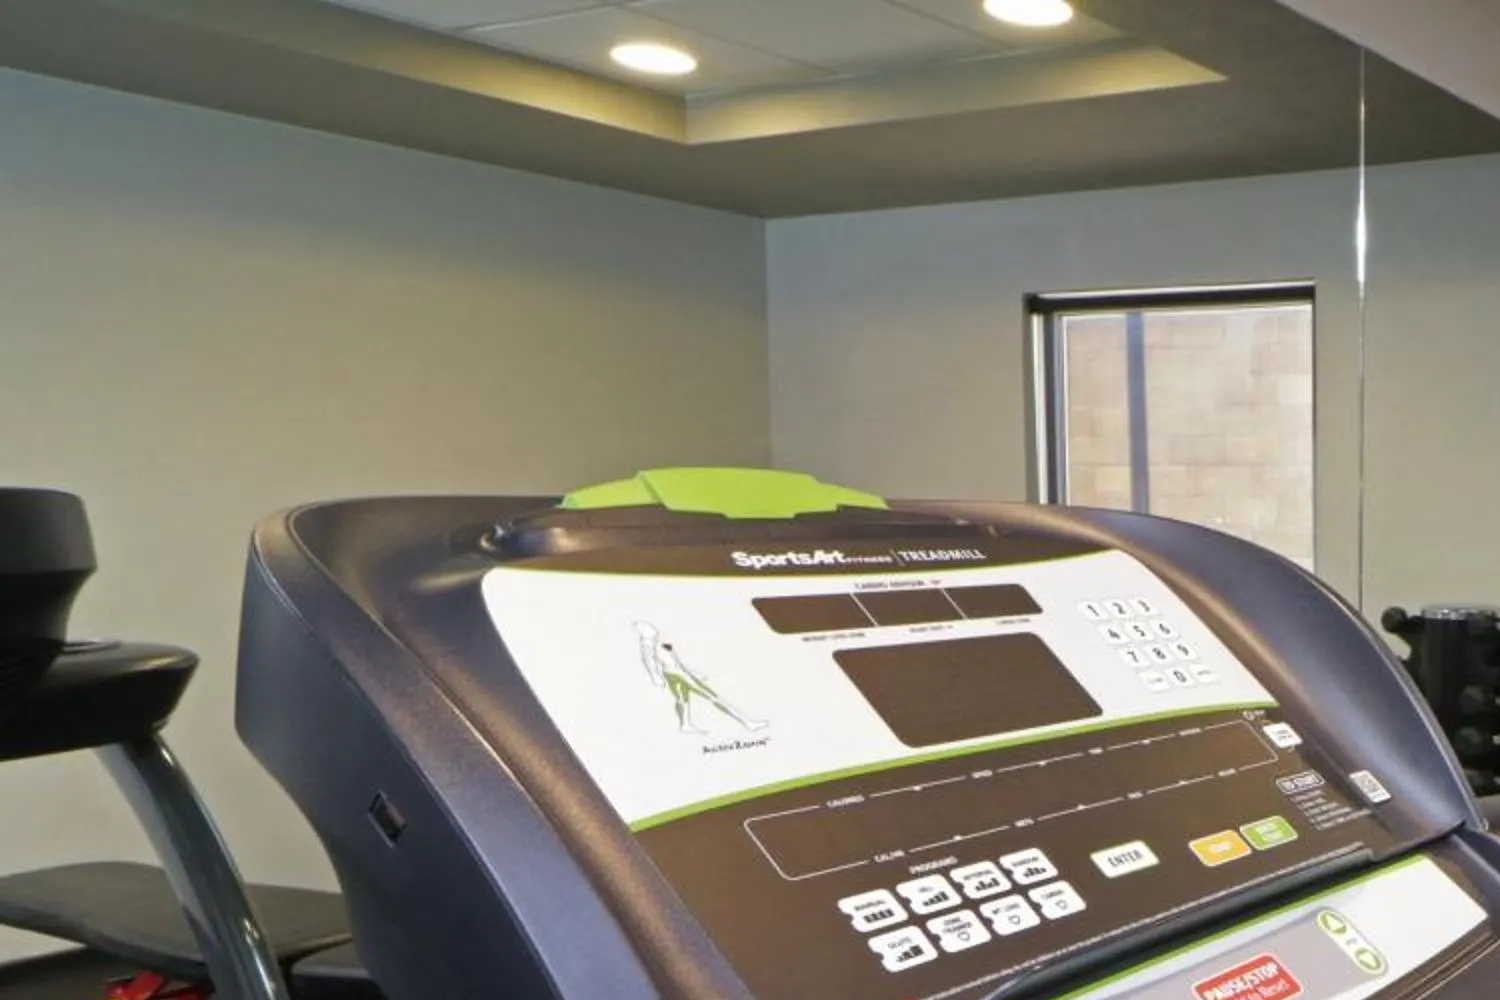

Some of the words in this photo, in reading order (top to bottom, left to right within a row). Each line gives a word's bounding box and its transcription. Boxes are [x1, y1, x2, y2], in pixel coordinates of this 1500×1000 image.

[731, 550, 845, 569] SportsArt
[899, 549, 986, 562] TREADMILL
[1173, 669, 1187, 683] 0
[1107, 849, 1145, 868] ENTER
[1257, 977, 1291, 998] Reset
